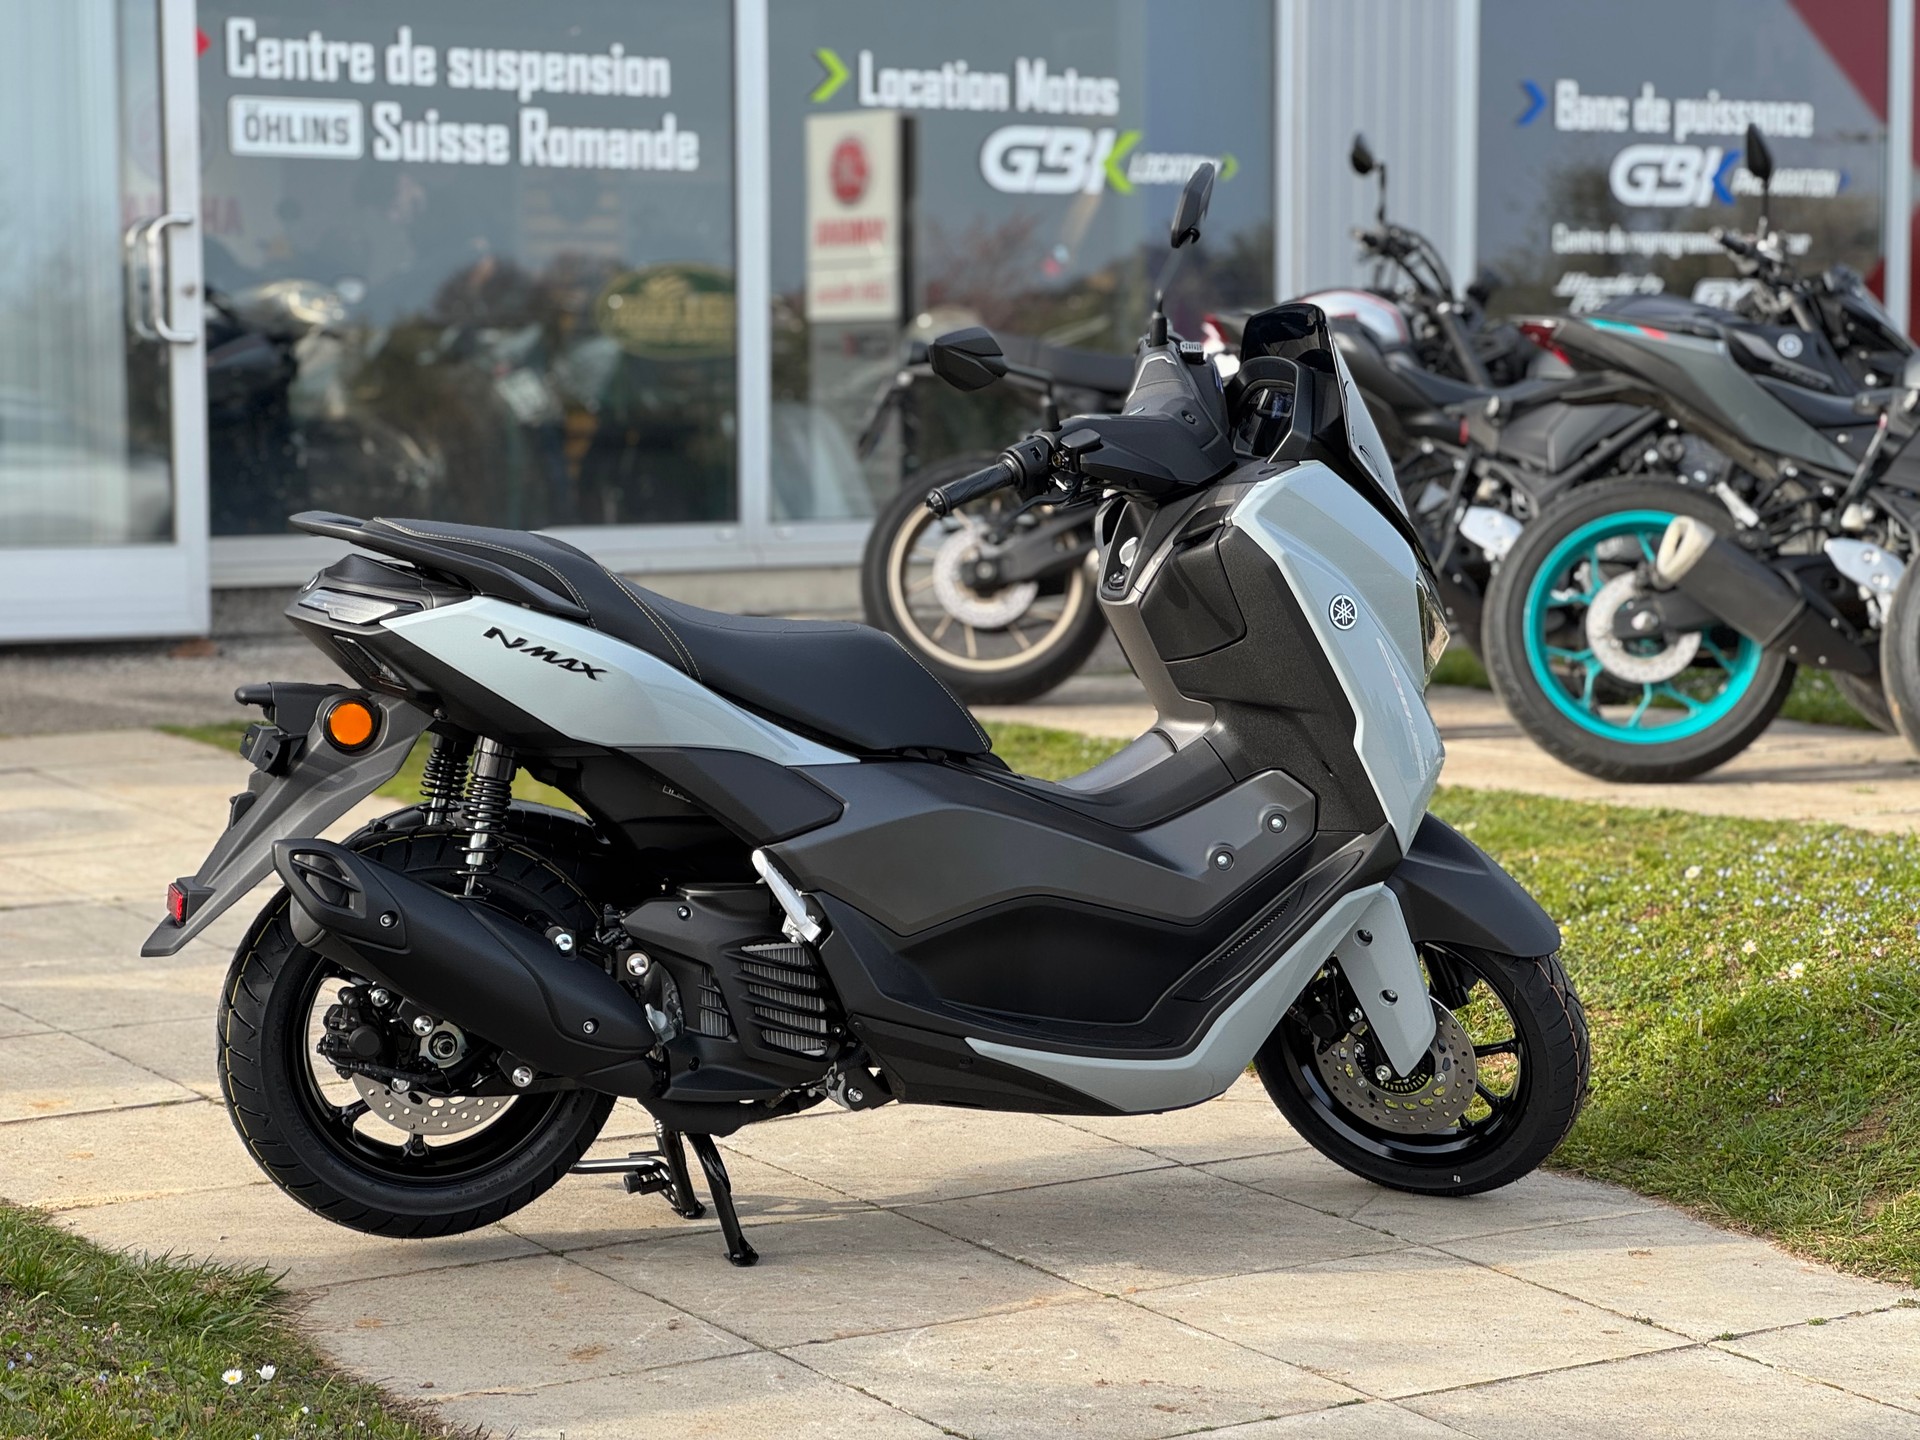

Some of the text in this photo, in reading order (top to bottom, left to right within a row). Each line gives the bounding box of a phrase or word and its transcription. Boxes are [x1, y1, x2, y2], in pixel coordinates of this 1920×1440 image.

[227, 18, 671, 103] Centre de suspension
[858, 50, 1120, 116] Location Motos
[244, 106, 350, 145] ÖHLINS
[372, 101, 700, 171] Suisse Romande
[1555, 79, 1815, 143] Banc de puissance
[482, 626, 608, 682] NMAX
